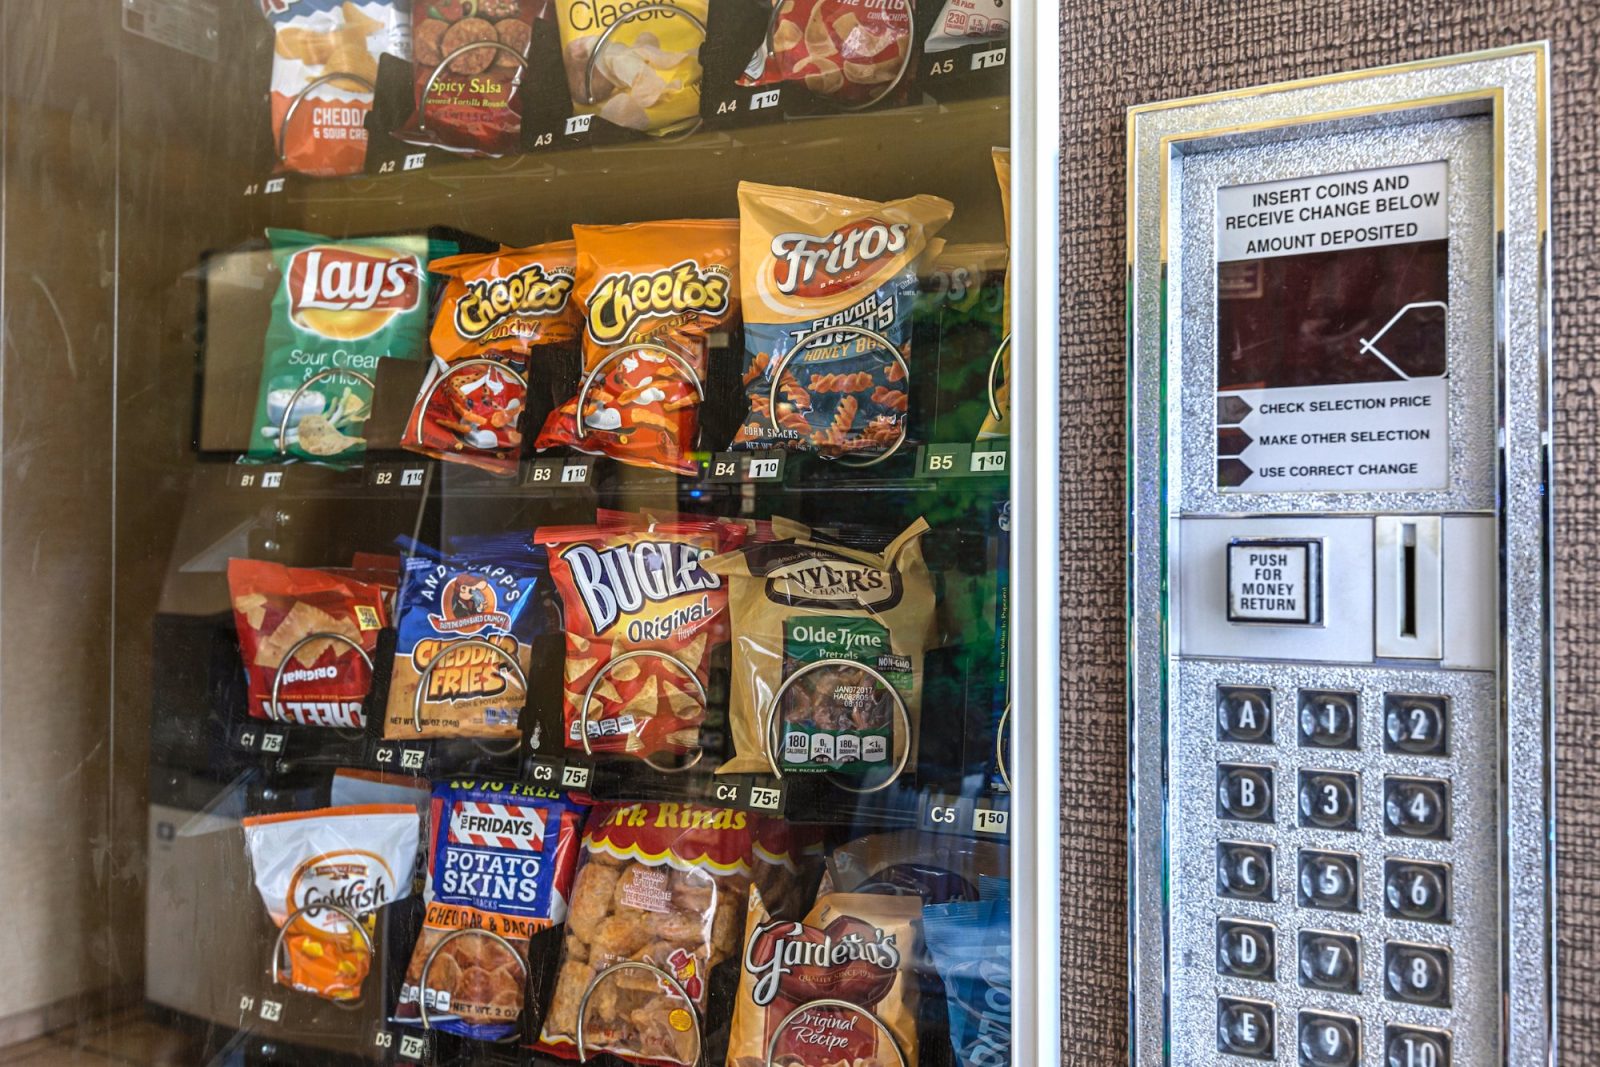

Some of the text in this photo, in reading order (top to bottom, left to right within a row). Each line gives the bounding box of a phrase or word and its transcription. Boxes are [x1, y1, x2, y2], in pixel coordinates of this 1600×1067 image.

[947, 12, 966, 25] 230
[930, 59, 954, 76] A5
[430, 78, 502, 96] Spicy Salsa
[717, 100, 737, 115] A4
[313, 129, 321, 139] &
[323, 128, 347, 140] SOUR
[535, 133, 553, 147] A3
[379, 161, 396, 174] A2
[244, 184, 259, 196] A1
[1252, 175, 1410, 207] INSERT COINS AND
[1225, 192, 1440, 230] RECEIVE CHANGE BELOW
[1246, 222, 1418, 254] AMOUNT DEPOSITED
[771, 223, 910, 295] Fritos
[298, 251, 417, 310] Lay's
[820, 270, 862, 290] BRAND
[456, 264, 574, 338] Cheetos
[586, 260, 730, 345] Cheetos
[812, 294, 878, 331] FLAVOR
[288, 349, 328, 365] Sour
[803, 342, 850, 361] HONEY
[303, 369, 312, 383] &
[1259, 395, 1432, 415] CHECK SELECTION PRICE
[744, 426, 799, 440] CORN SNACKS
[1259, 429, 1430, 446] MAKE OTHER SELECTION
[715, 462, 735, 477] B4
[929, 455, 953, 470] B5
[1259, 463, 1418, 478] USE CORRECT CHANGE
[241, 475, 255, 487] B1
[376, 472, 392, 485] B2
[533, 468, 551, 481] B3
[1249, 554, 1288, 567] PUSH
[421, 564, 457, 602] AND
[1255, 568, 1282, 581] FOR
[563, 541, 721, 634] BUGLES
[1242, 583, 1294, 596] MONEY
[1240, 598, 1296, 611] RETURN
[793, 626, 882, 650] Olde Tyme
[819, 649, 858, 660] Pretzels
[878, 657, 910, 669] NON-GMO
[429, 665, 505, 696] FRIES
[390, 717, 402, 725] NET
[1239, 701, 1256, 729] A
[1325, 704, 1336, 734] 1
[1411, 709, 1426, 740] 2
[241, 733, 255, 746] C1
[789, 734, 807, 748] 180
[376, 749, 393, 763] C2
[534, 766, 587, 784] C3 75¢
[716, 785, 779, 806] C4 75¢
[1241, 778, 1256, 807] B
[1323, 784, 1339, 815] 3
[654, 802, 748, 830] Rinds
[931, 806, 956, 824] C5
[1410, 793, 1427, 823] 4
[468, 815, 533, 837] FRIDAYS
[445, 850, 540, 878] POTATO
[1242, 856, 1256, 886] C
[442, 869, 538, 903] SKINS
[1322, 865, 1339, 895] 5
[1411, 875, 1427, 905] 6
[304, 876, 386, 918] Goldfish
[428, 906, 483, 929] CHEDDAR
[489, 916, 497, 931] &
[1241, 934, 1257, 964] D
[745, 921, 900, 1007] Gardetto's
[1326, 946, 1341, 975] 7
[1411, 957, 1428, 989] 8
[240, 996, 254, 1011] D1
[454, 1002, 472, 1013] NET
[495, 1008, 502, 1016] 2
[1242, 1013, 1255, 1042] E
[375, 1032, 392, 1048] D3
[792, 1026, 849, 1053] Recipe
[1325, 1026, 1340, 1056] 9
[1403, 1039, 1436, 1067] 10
